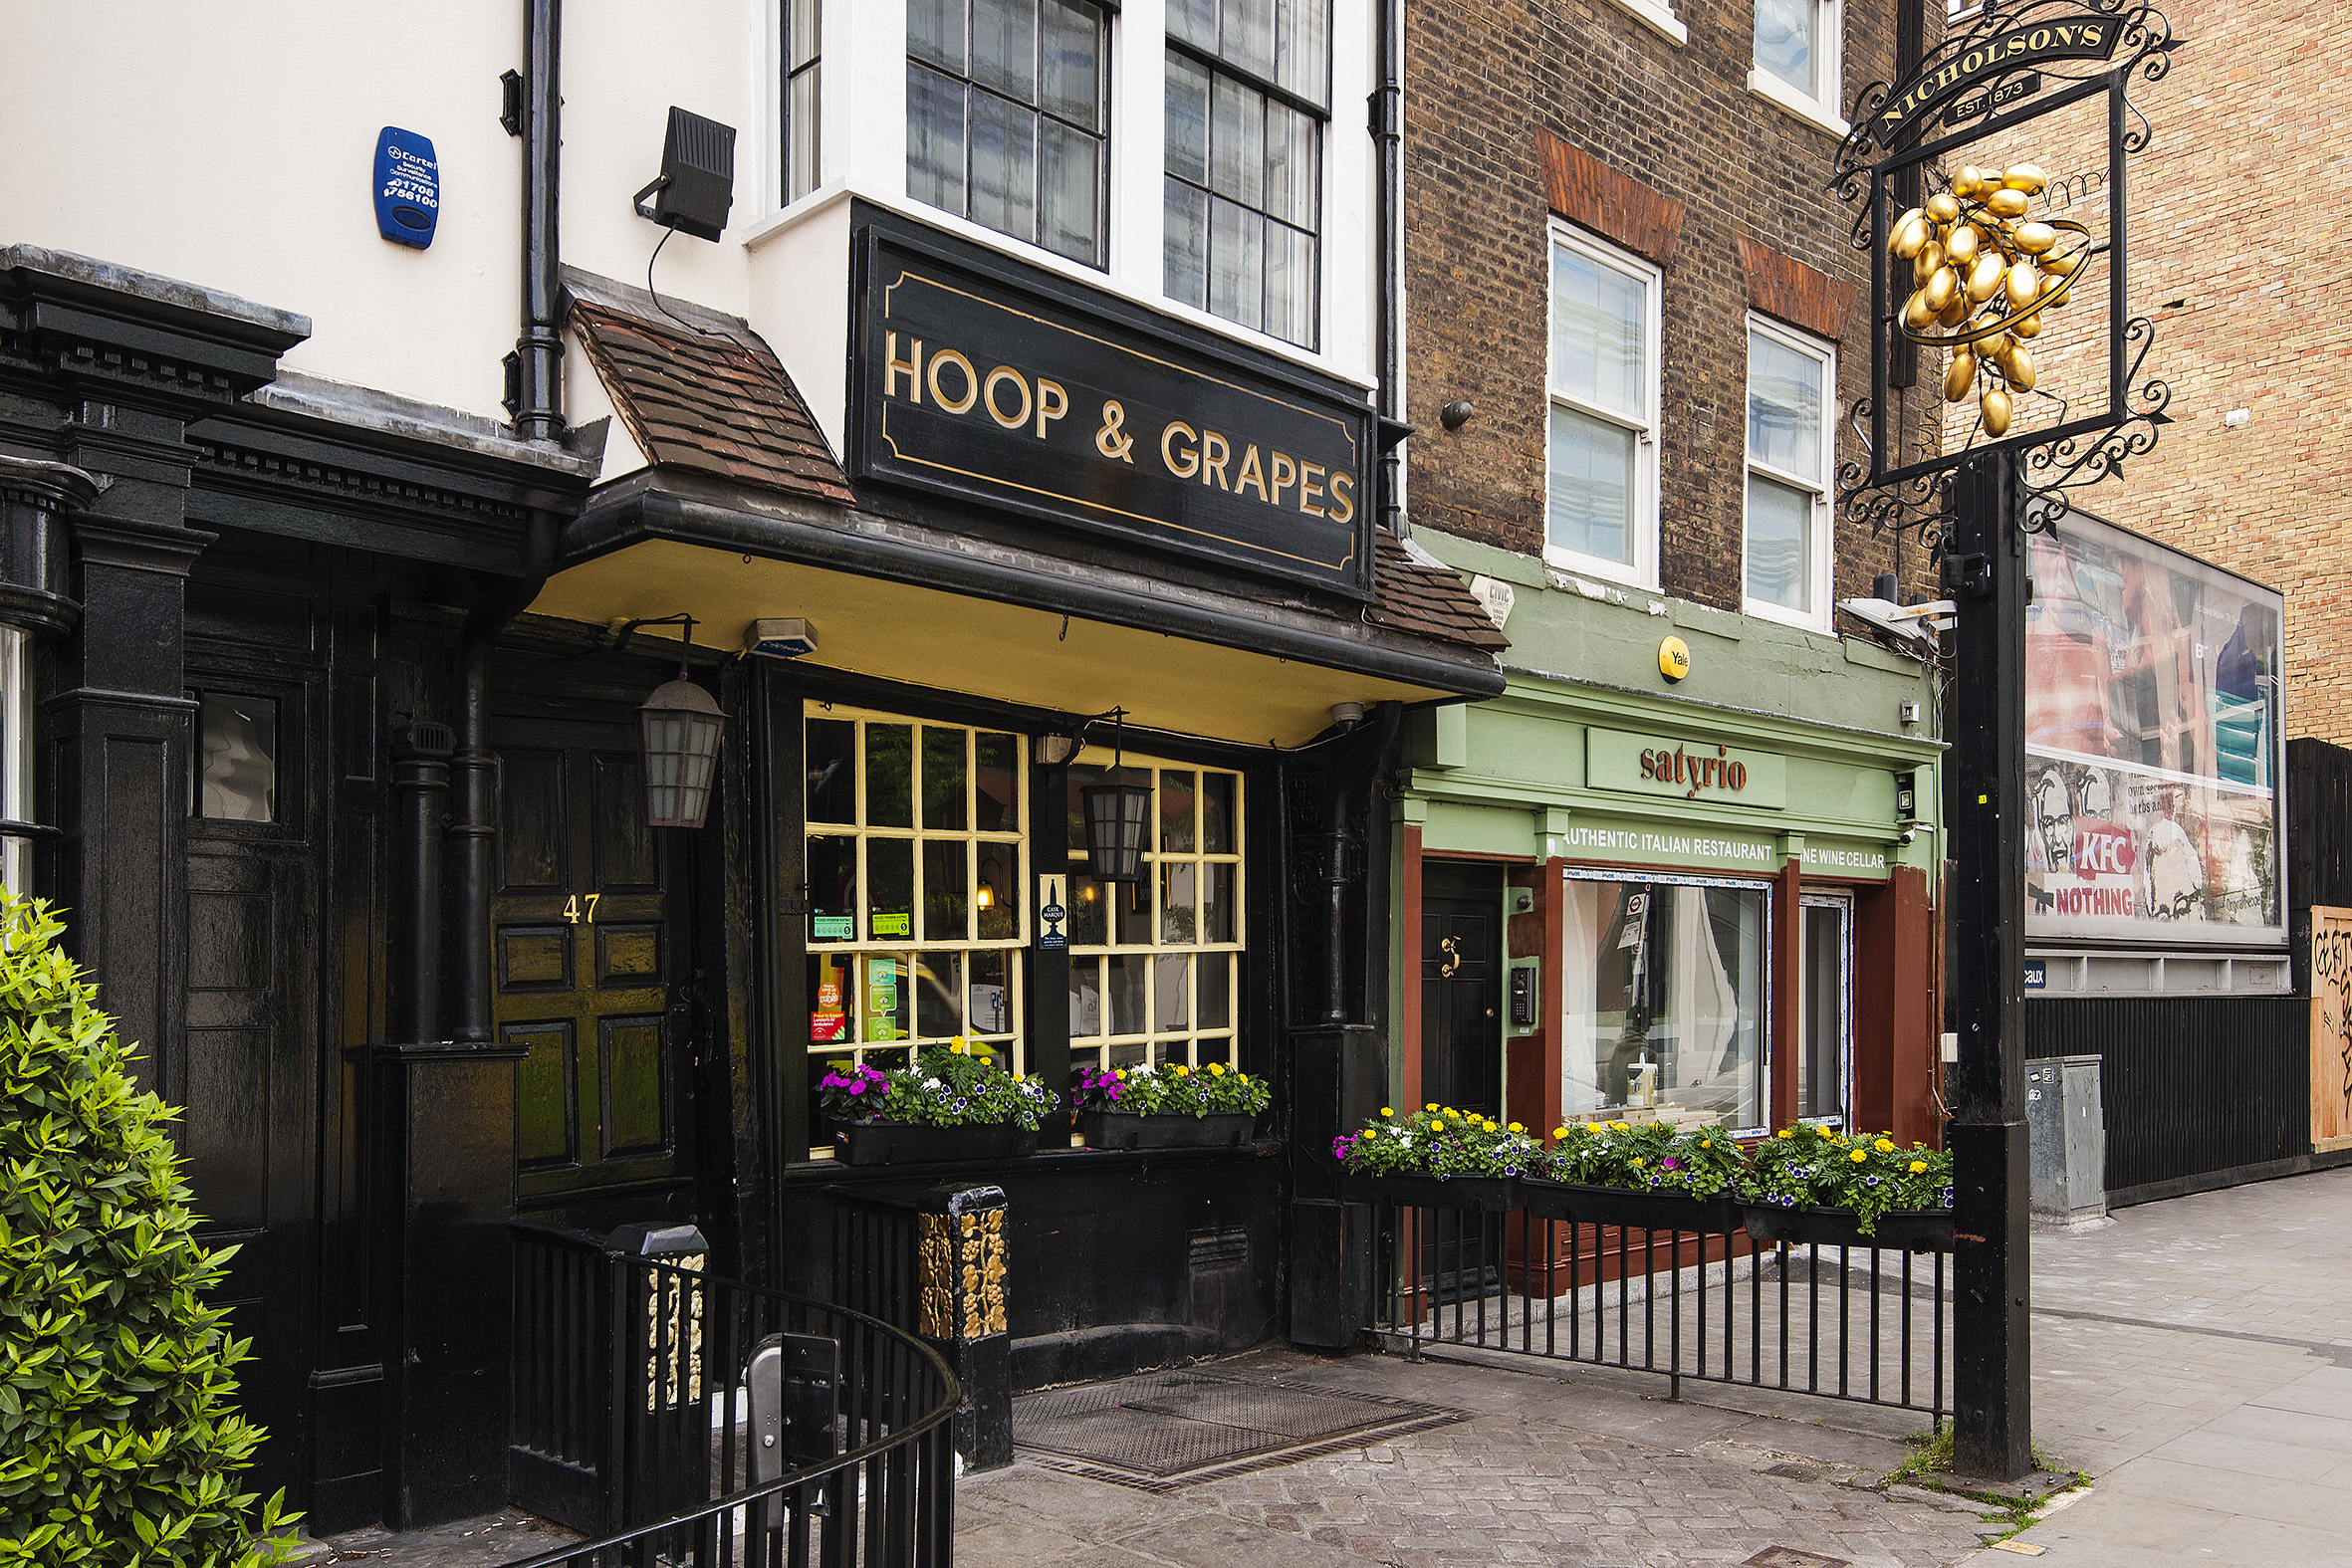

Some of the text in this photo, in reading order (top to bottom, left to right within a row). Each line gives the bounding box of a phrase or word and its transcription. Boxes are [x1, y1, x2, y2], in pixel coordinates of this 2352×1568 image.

[1880, 24, 2104, 132] NICHOLSON'S
[389, 168, 438, 189] Communications
[396, 165, 432, 180] Surveillance
[402, 161, 426, 174] Security
[389, 186, 438, 208] 756100
[883, 329, 1355, 525] HOOP & GRAPES
[1490, 584, 1509, 602] CIVIC
[1671, 650, 1689, 667] Yale
[1640, 742, 1748, 799] satyrio
[1641, 833, 1691, 854] ITALIAN
[1694, 837, 1772, 861] RESTAURANT
[1818, 848, 1845, 866] WINE
[1846, 851, 1885, 869] CELLAR
[2079, 831, 2127, 874] KFC
[563, 892, 601, 924] 47
[2055, 886, 2133, 916] NOTHING
